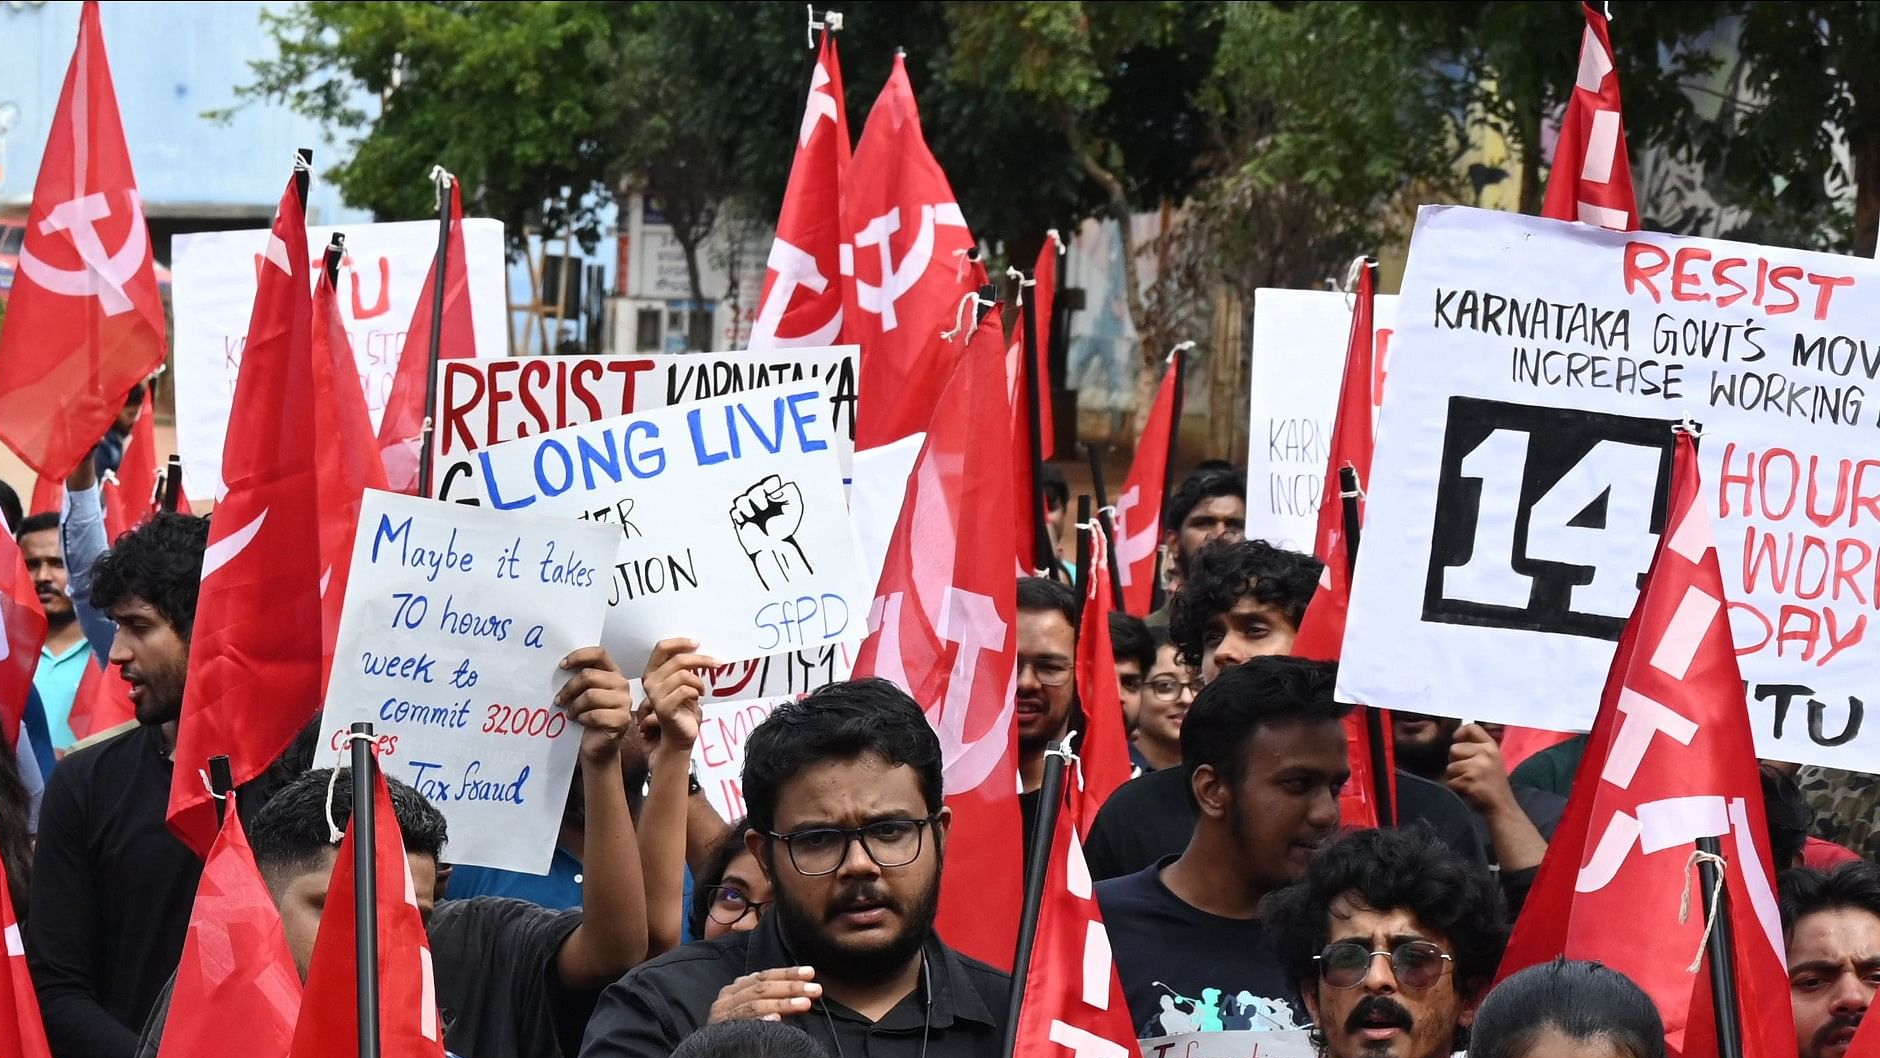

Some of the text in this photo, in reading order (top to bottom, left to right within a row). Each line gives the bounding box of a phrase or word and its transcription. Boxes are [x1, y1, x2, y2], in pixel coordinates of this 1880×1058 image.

[1623, 240, 1855, 321] RESIST
[1434, 287, 1630, 352] KARNATAKA
[1653, 314, 1766, 364] GOVT'S
[442, 360, 656, 456] RESIST
[1512, 347, 1864, 427] INCREASE WORKING
[478, 420, 667, 511] LONG
[687, 390, 828, 467] LIVE
[370, 513, 595, 588] Maybe it takes
[1441, 428, 1665, 621] 14
[391, 592, 544, 649] 70 hours a
[1727, 602, 1867, 668] DAY
[362, 650, 479, 689] week to
[379, 697, 568, 739] commit 32000
[1743, 680, 1864, 747] TU
[408, 760, 531, 805] Tax fraud
